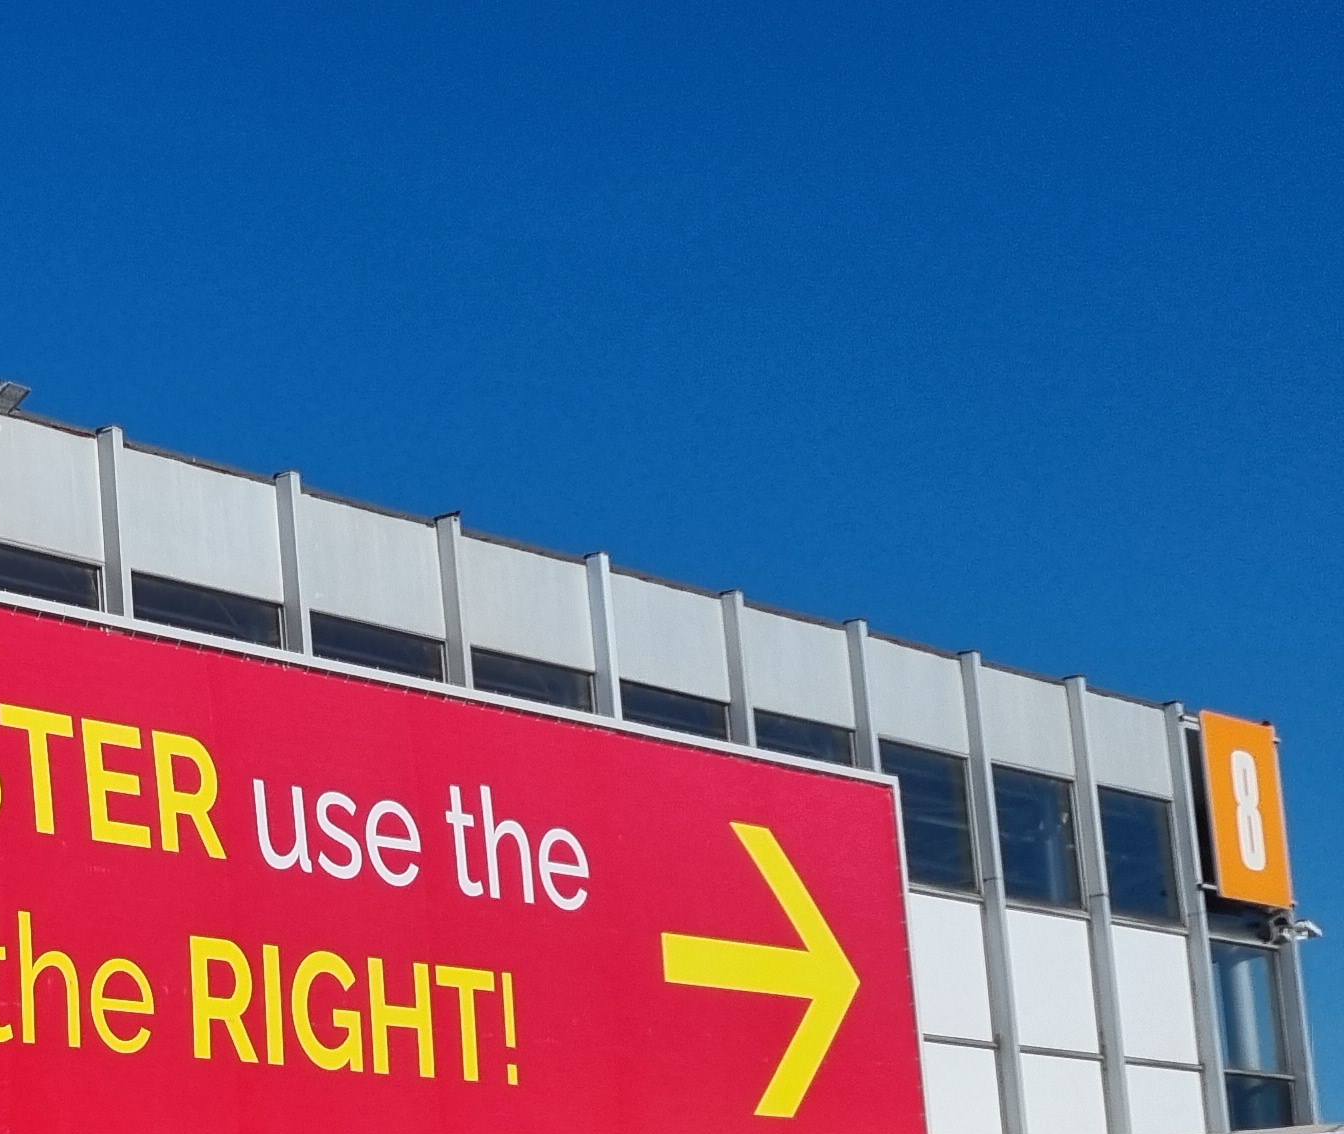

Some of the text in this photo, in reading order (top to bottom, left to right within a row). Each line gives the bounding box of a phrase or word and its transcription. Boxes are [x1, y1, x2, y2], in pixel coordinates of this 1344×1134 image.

[252, 778, 422, 887] use
[445, 785, 590, 911] the
[1230, 750, 1267, 872] 8
[189, 935, 519, 1086] RIGHT!
